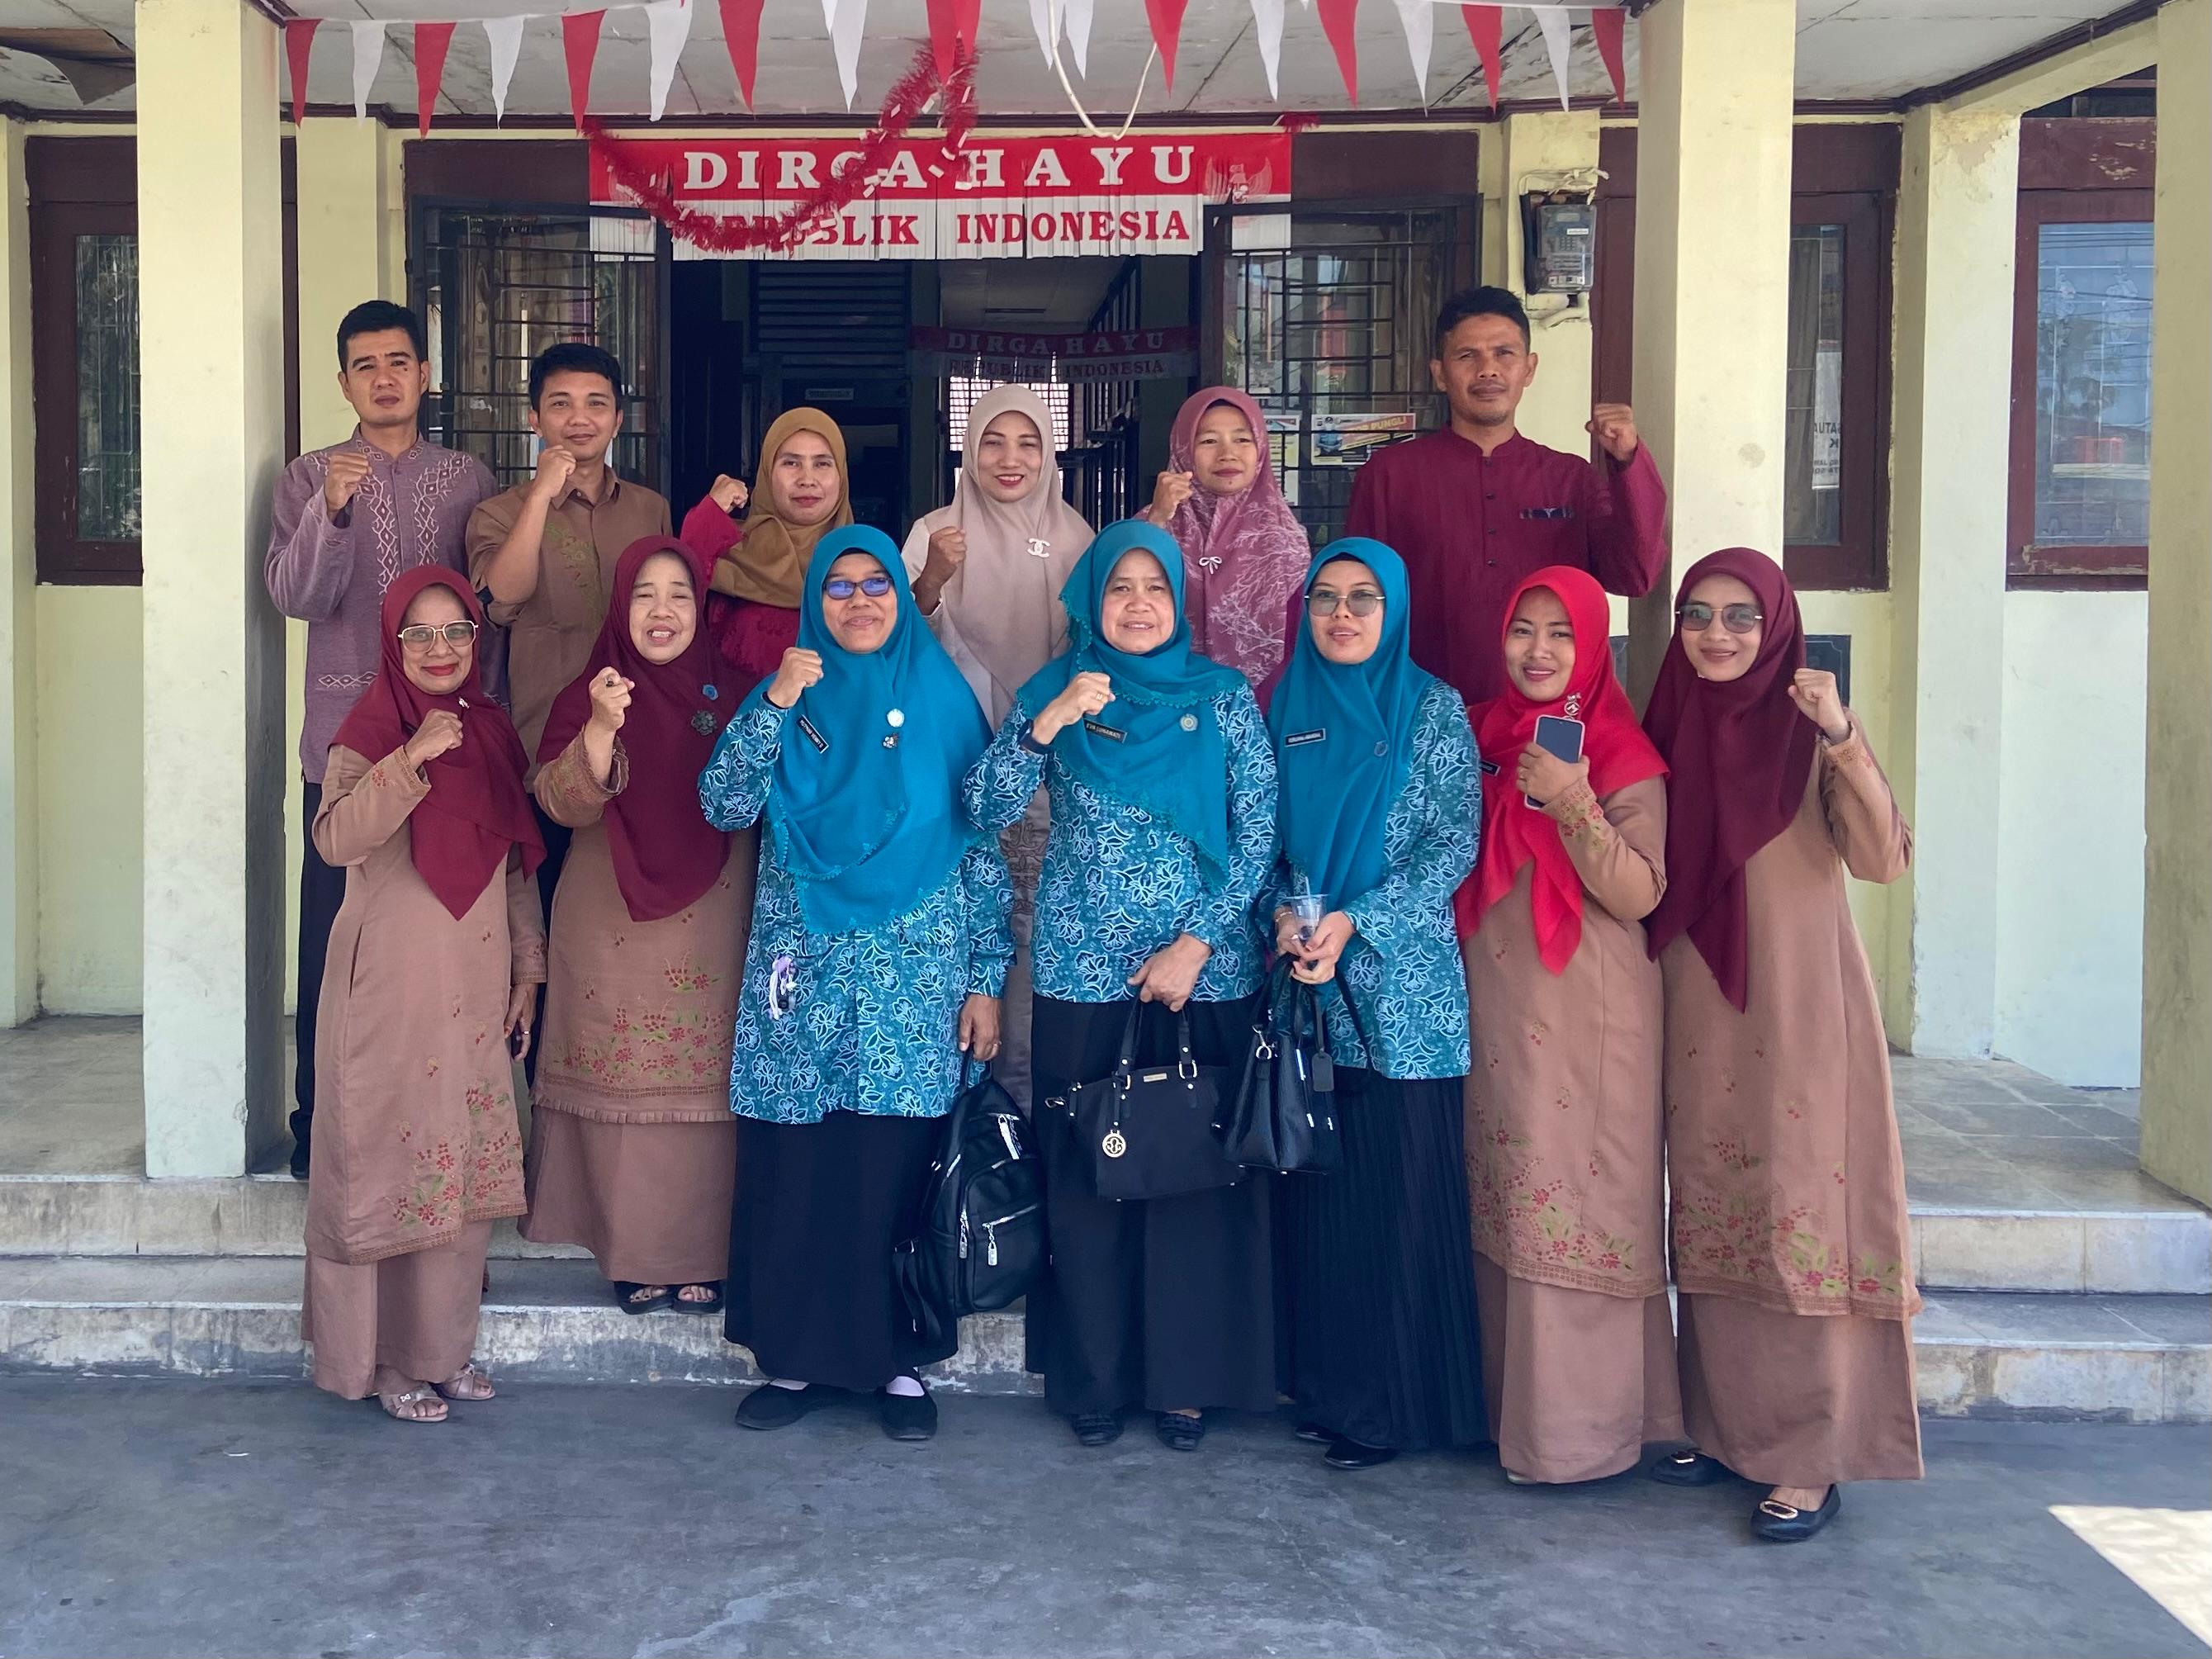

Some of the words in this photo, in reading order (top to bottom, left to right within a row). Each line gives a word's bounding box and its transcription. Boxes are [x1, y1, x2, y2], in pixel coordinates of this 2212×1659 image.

[691, 215, 920, 246] BLIK
[956, 210, 1191, 244] INDONESIA
[1065, 359, 1164, 378] INDONESIA
